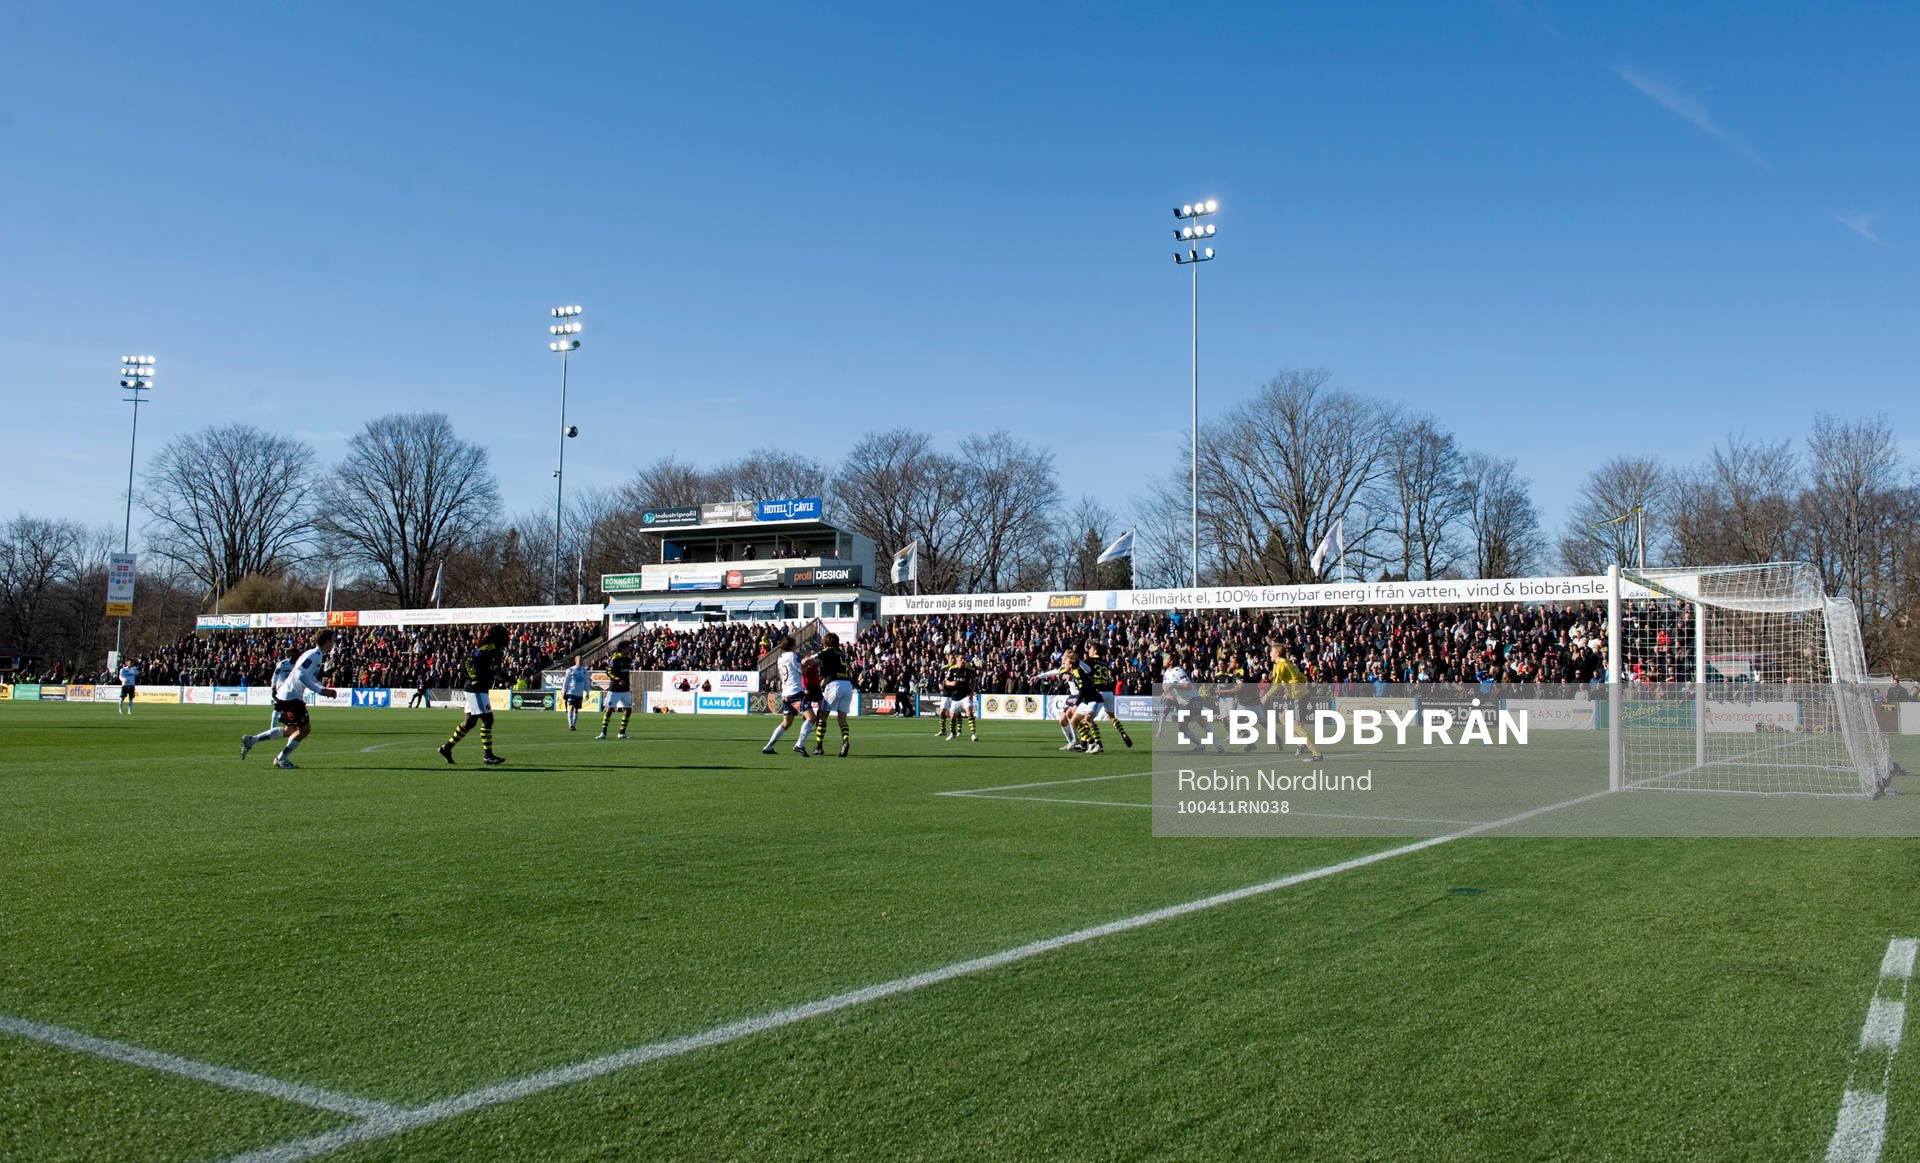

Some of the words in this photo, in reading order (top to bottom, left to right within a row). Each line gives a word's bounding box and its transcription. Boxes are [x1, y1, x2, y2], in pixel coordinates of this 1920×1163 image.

[764, 504, 787, 514] HOTELL
[655, 511, 697, 520] Industriprofil
[815, 570, 849, 580] DESIGN
[1132, 592, 1192, 605] Källmärkt
[1196, 592, 1210, 604] el,
[1216, 589, 1258, 603] 100%
[1263, 587, 1320, 603] förnybar
[1376, 585, 1404, 599] från
[1409, 585, 1461, 599] vatten,
[1467, 583, 1499, 597] vind
[1503, 582, 1515, 596] &
[1520, 579, 1609, 595] biobränsle.
[936, 597, 956, 610] nöja
[959, 597, 972, 610] sig
[975, 597, 995, 608] med
[997, 595, 1033, 610] lagom?
[1094, 665, 1108, 680] 33
[70, 687, 91, 698] office
[355, 691, 387, 705] YIT
[1315, 702, 1329, 710] till
